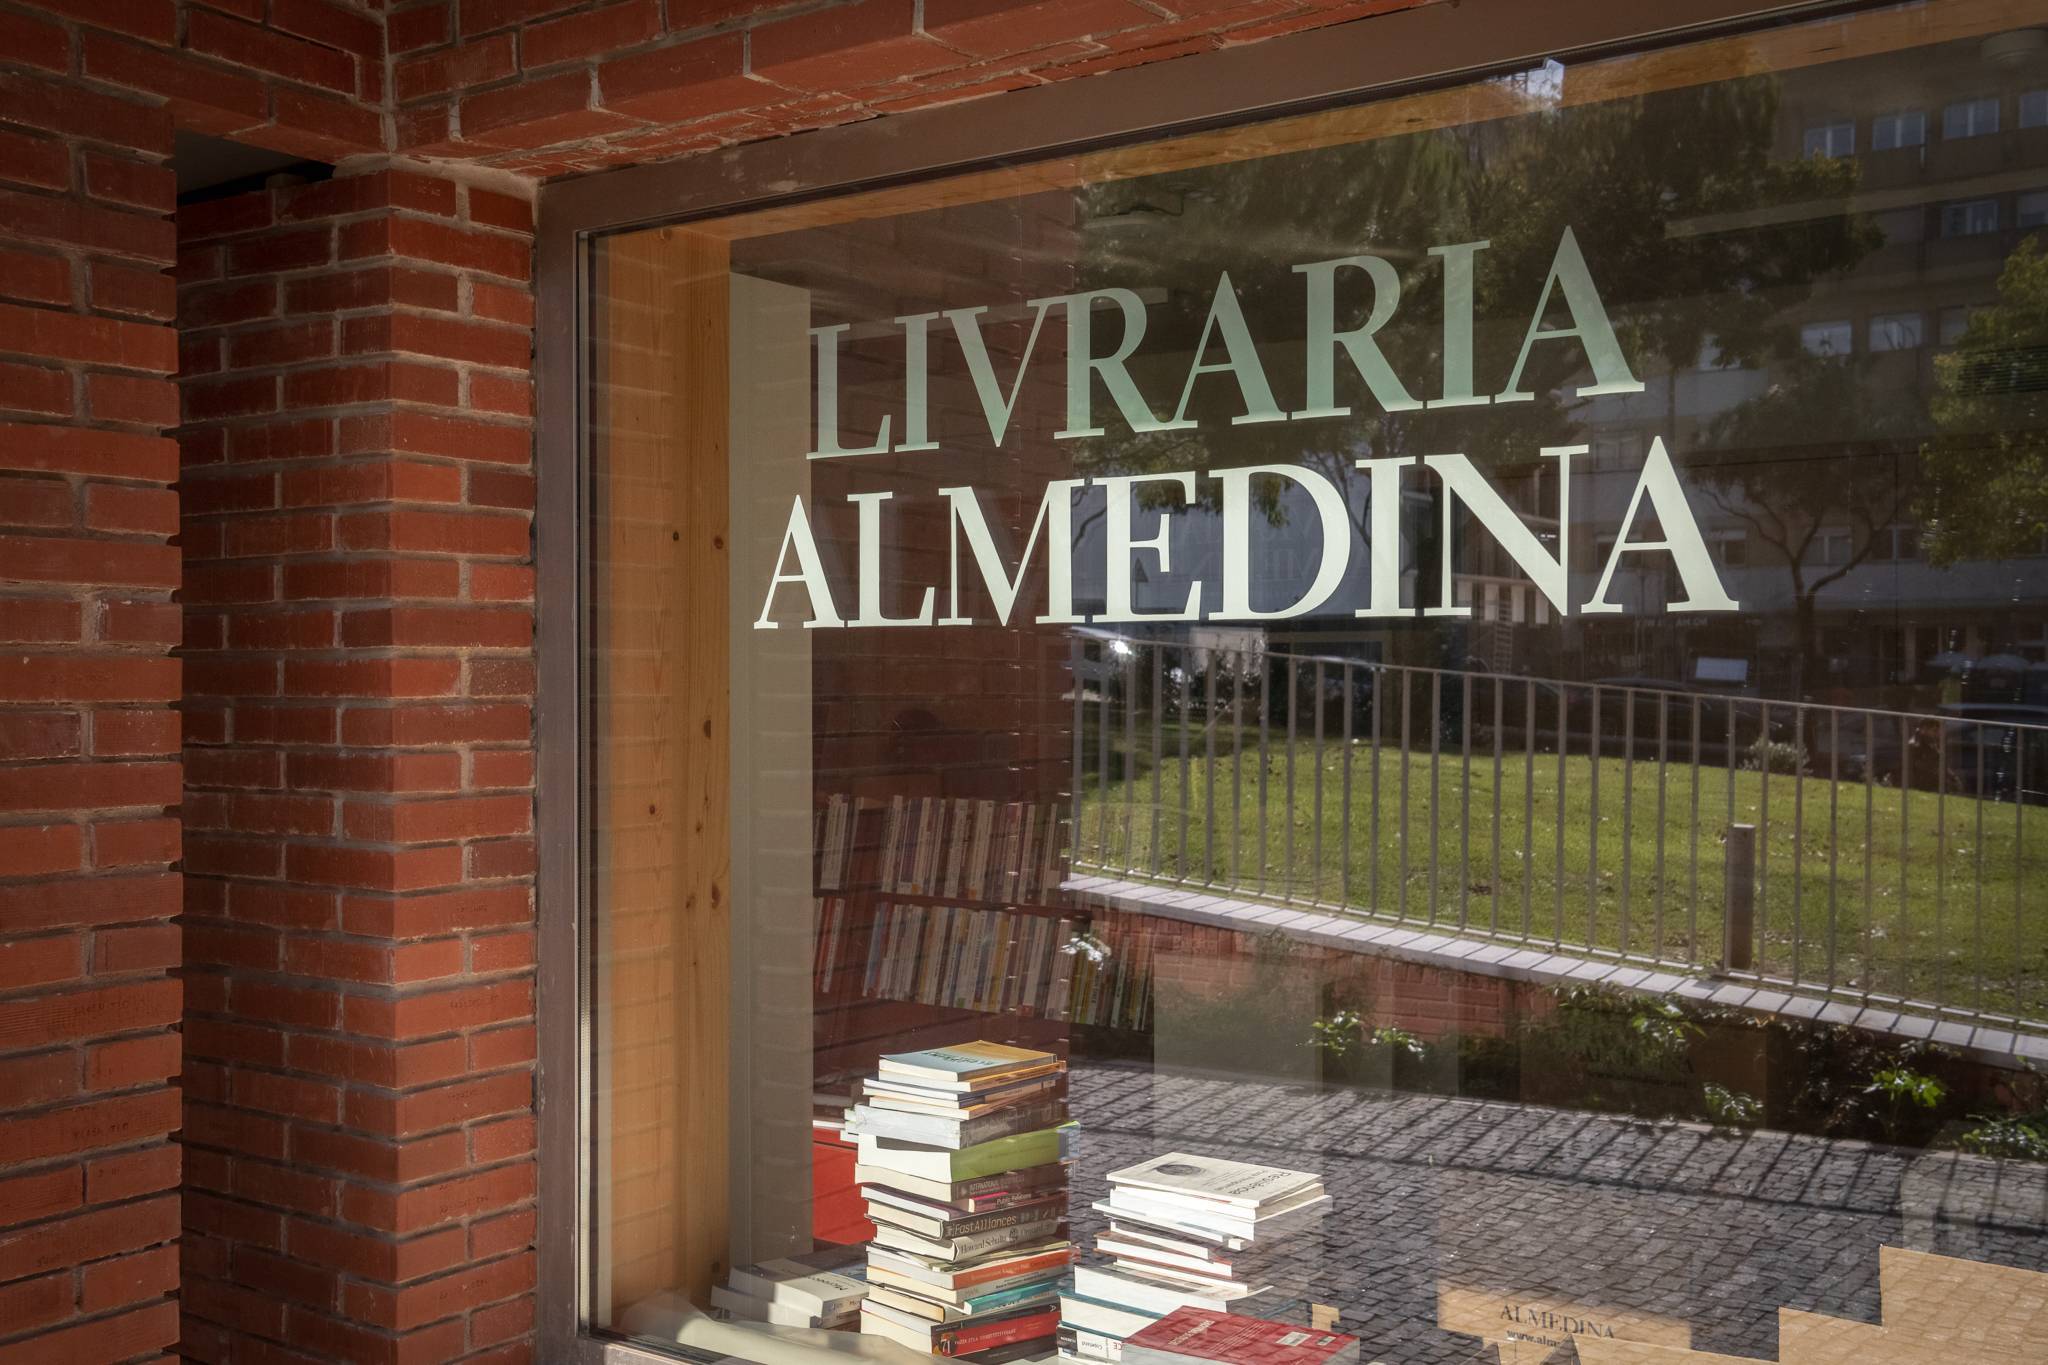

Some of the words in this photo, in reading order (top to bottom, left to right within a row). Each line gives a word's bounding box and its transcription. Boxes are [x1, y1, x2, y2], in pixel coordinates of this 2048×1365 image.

[806, 225, 1645, 460] LIVRARIA
[753, 435, 1740, 629] ALMEDINA
[1500, 1304, 1615, 1339] ALMEDINA
